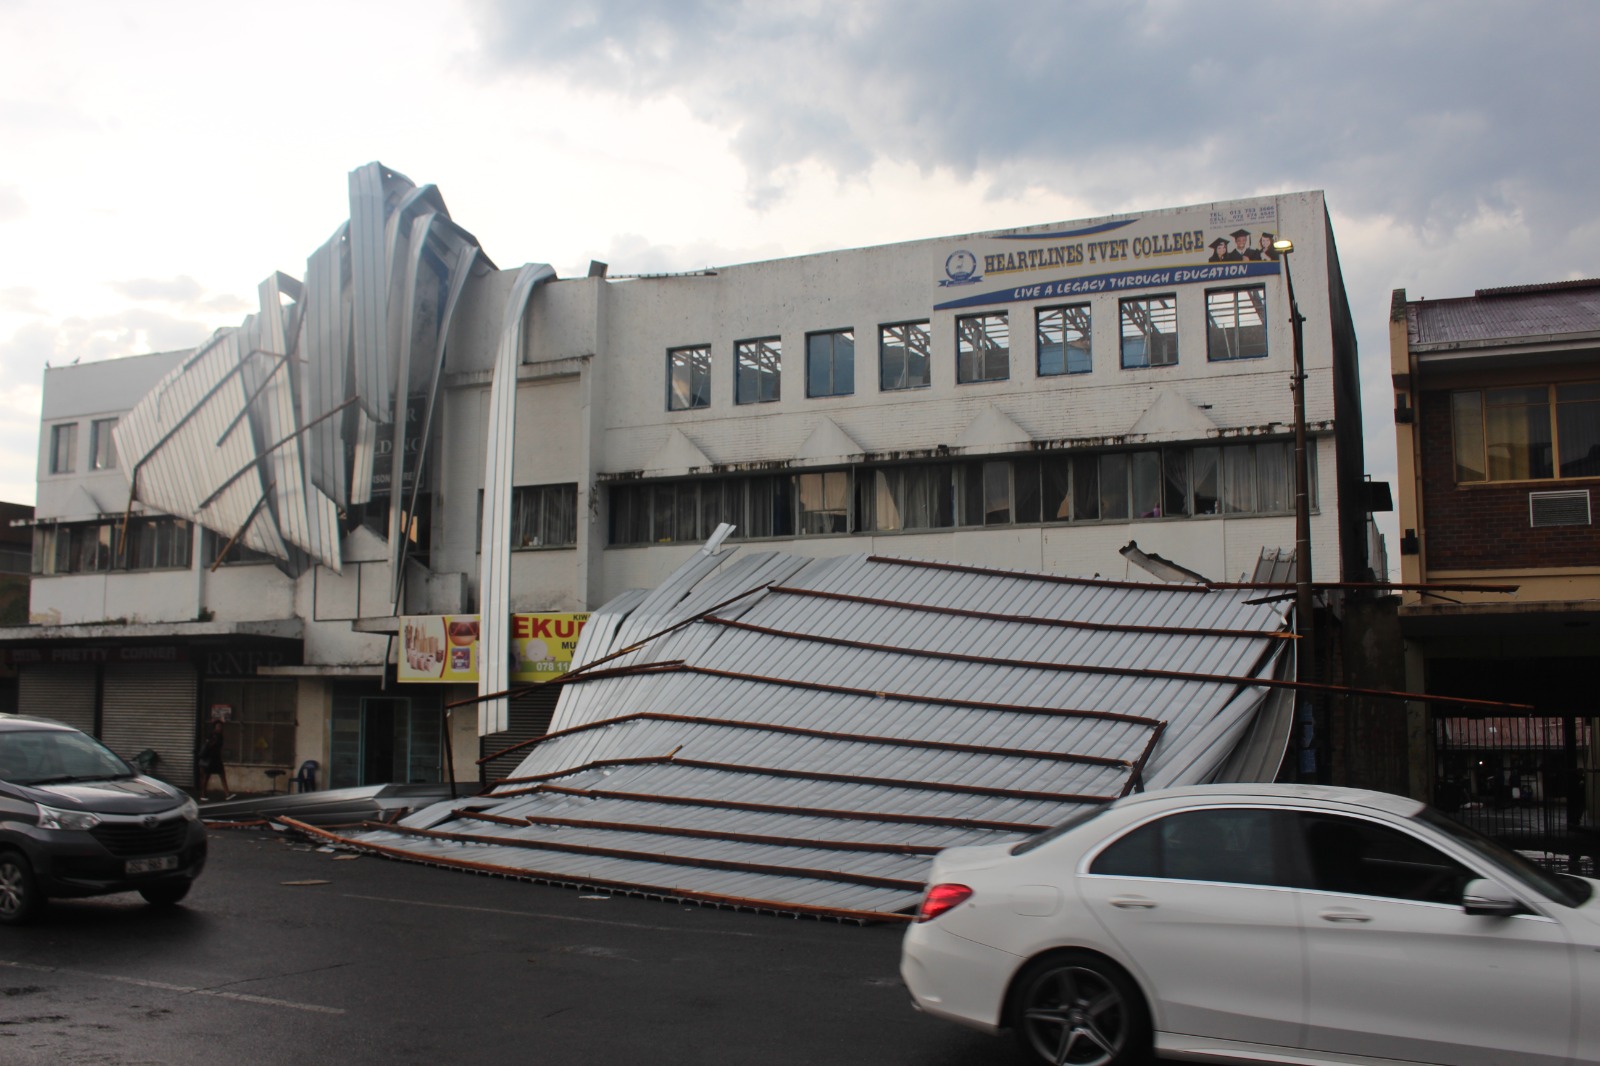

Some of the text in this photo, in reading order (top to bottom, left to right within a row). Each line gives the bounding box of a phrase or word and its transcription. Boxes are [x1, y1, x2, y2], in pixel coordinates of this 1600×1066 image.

[984, 230, 1205, 275] HEARTLINES TVET COLLEGE
[1014, 264, 1249, 299] LIVE A LEGACY THROUGH EDUCATION
[561, 641, 576, 649] MU
[51, 647, 110, 662] PRETTY
[120, 646, 177, 660] CORNER
[536, 662, 571, 672] 078 11
